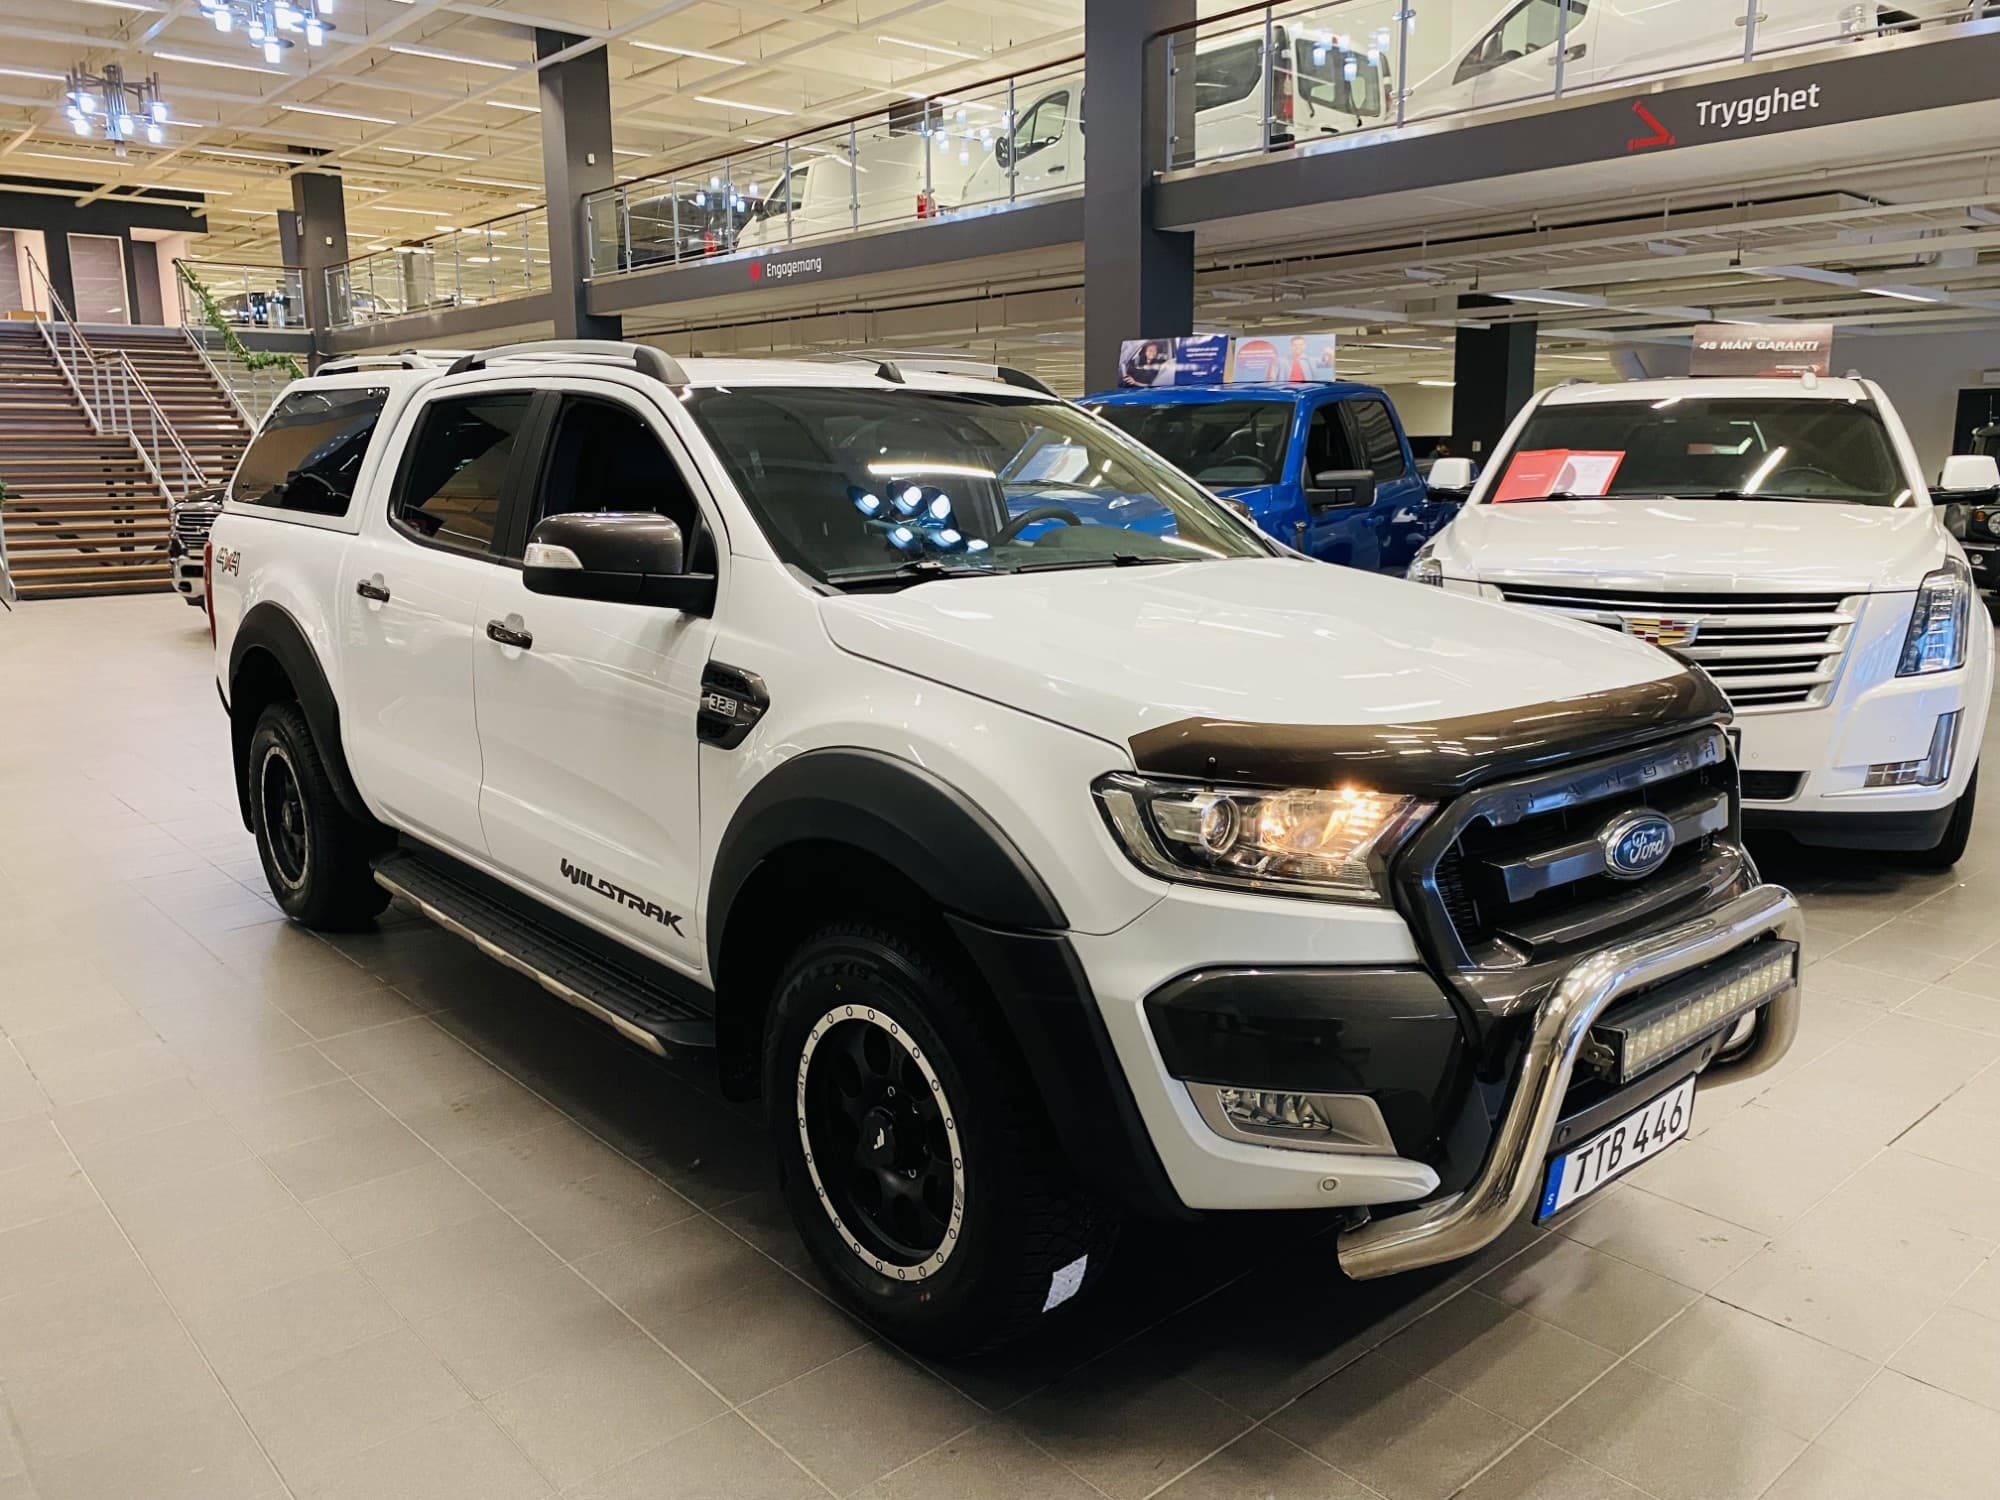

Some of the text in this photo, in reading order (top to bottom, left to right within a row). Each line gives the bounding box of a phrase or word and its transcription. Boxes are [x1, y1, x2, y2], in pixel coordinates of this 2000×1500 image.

[1696, 83, 1821, 128] Trygghet
[766, 257, 822, 279] Engagemang
[1756, 341, 1819, 351] GARANTI
[1629, 830, 1666, 865] Ford
[560, 858, 686, 938] WILDTRAK
[1574, 1089, 1684, 1194] TTB 446
[1546, 1193, 1555, 1205] S
